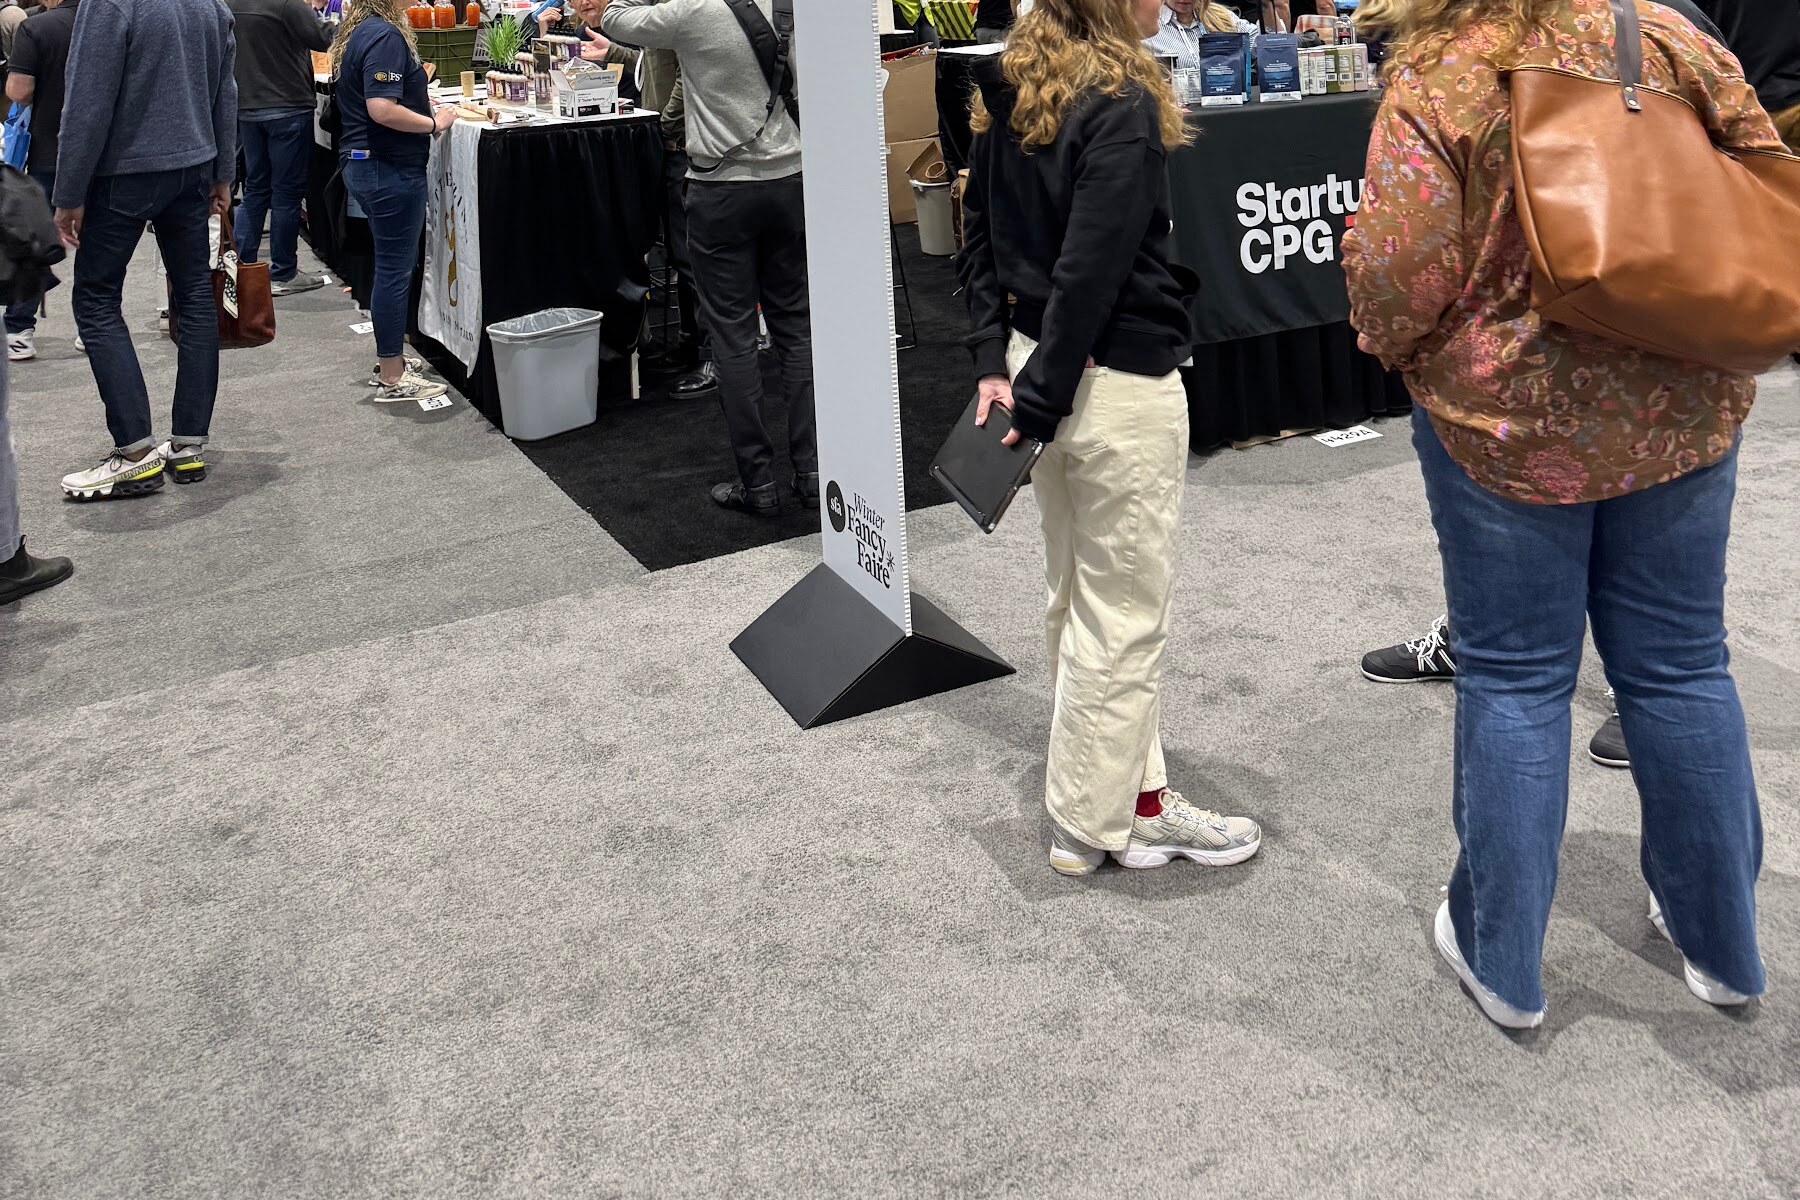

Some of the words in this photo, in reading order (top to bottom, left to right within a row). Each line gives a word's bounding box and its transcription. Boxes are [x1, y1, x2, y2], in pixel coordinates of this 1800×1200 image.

[1236, 173, 1366, 228] Startu
[1240, 219, 1334, 274] CPG
[846, 503, 887, 563] Fancy
[853, 491, 885, 531] Winter
[856, 538, 891, 589] Faire
